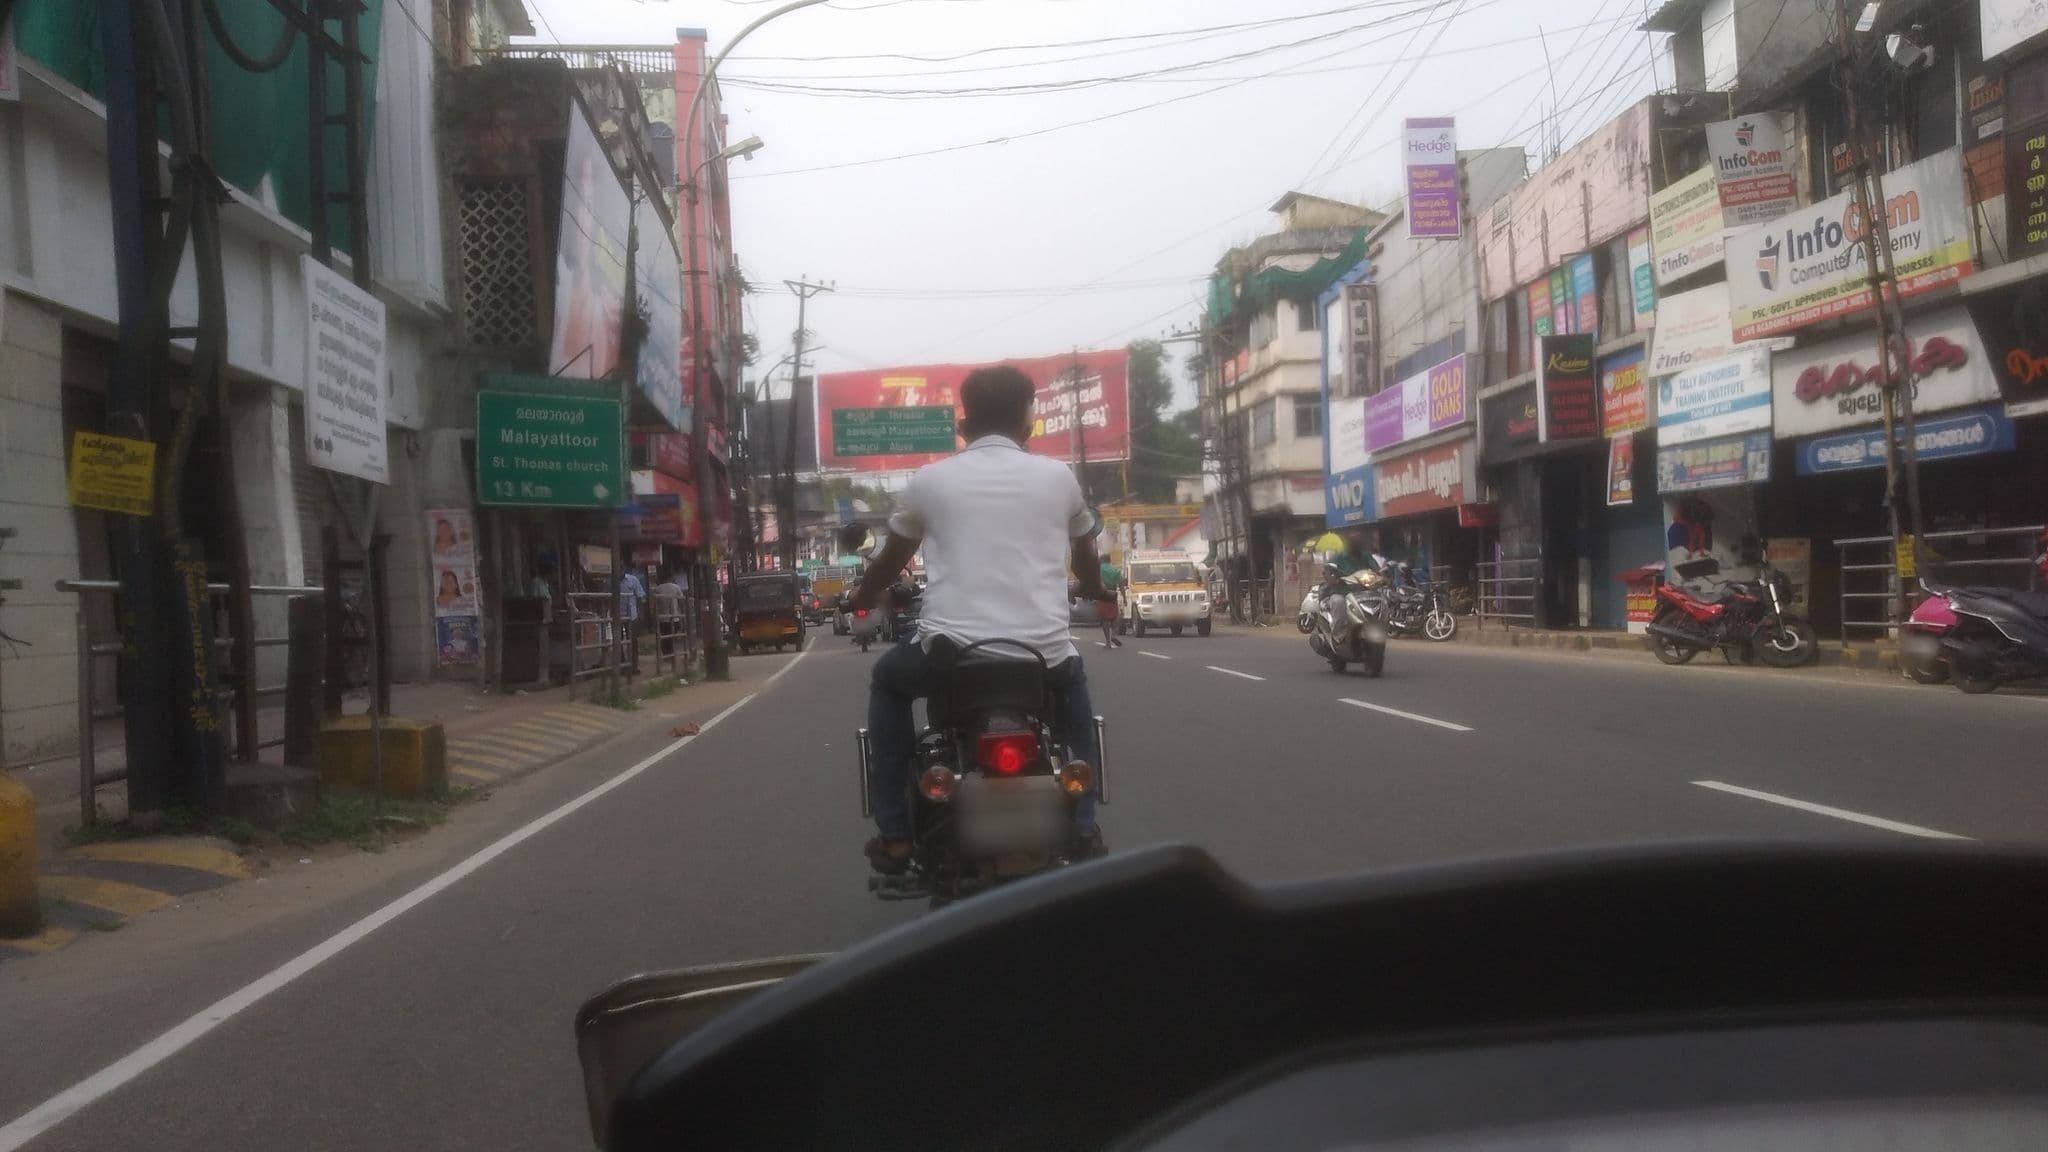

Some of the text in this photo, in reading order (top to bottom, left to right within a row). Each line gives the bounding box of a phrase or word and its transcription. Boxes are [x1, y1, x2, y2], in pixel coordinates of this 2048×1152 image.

[1408, 140, 1451, 154] Hedge
[1719, 150, 1783, 171] InfoCom
[1787, 190, 1920, 264] InfoCm
[1790, 252, 1852, 286] Computer
[1431, 366, 1462, 397] GOLD
[1431, 396, 1462, 422] LOANS
[501, 428, 600, 448] Malayattoor
[514, 456, 562, 471] Thomas
[566, 461, 609, 473] church
[494, 480, 552, 498] 13 Km
